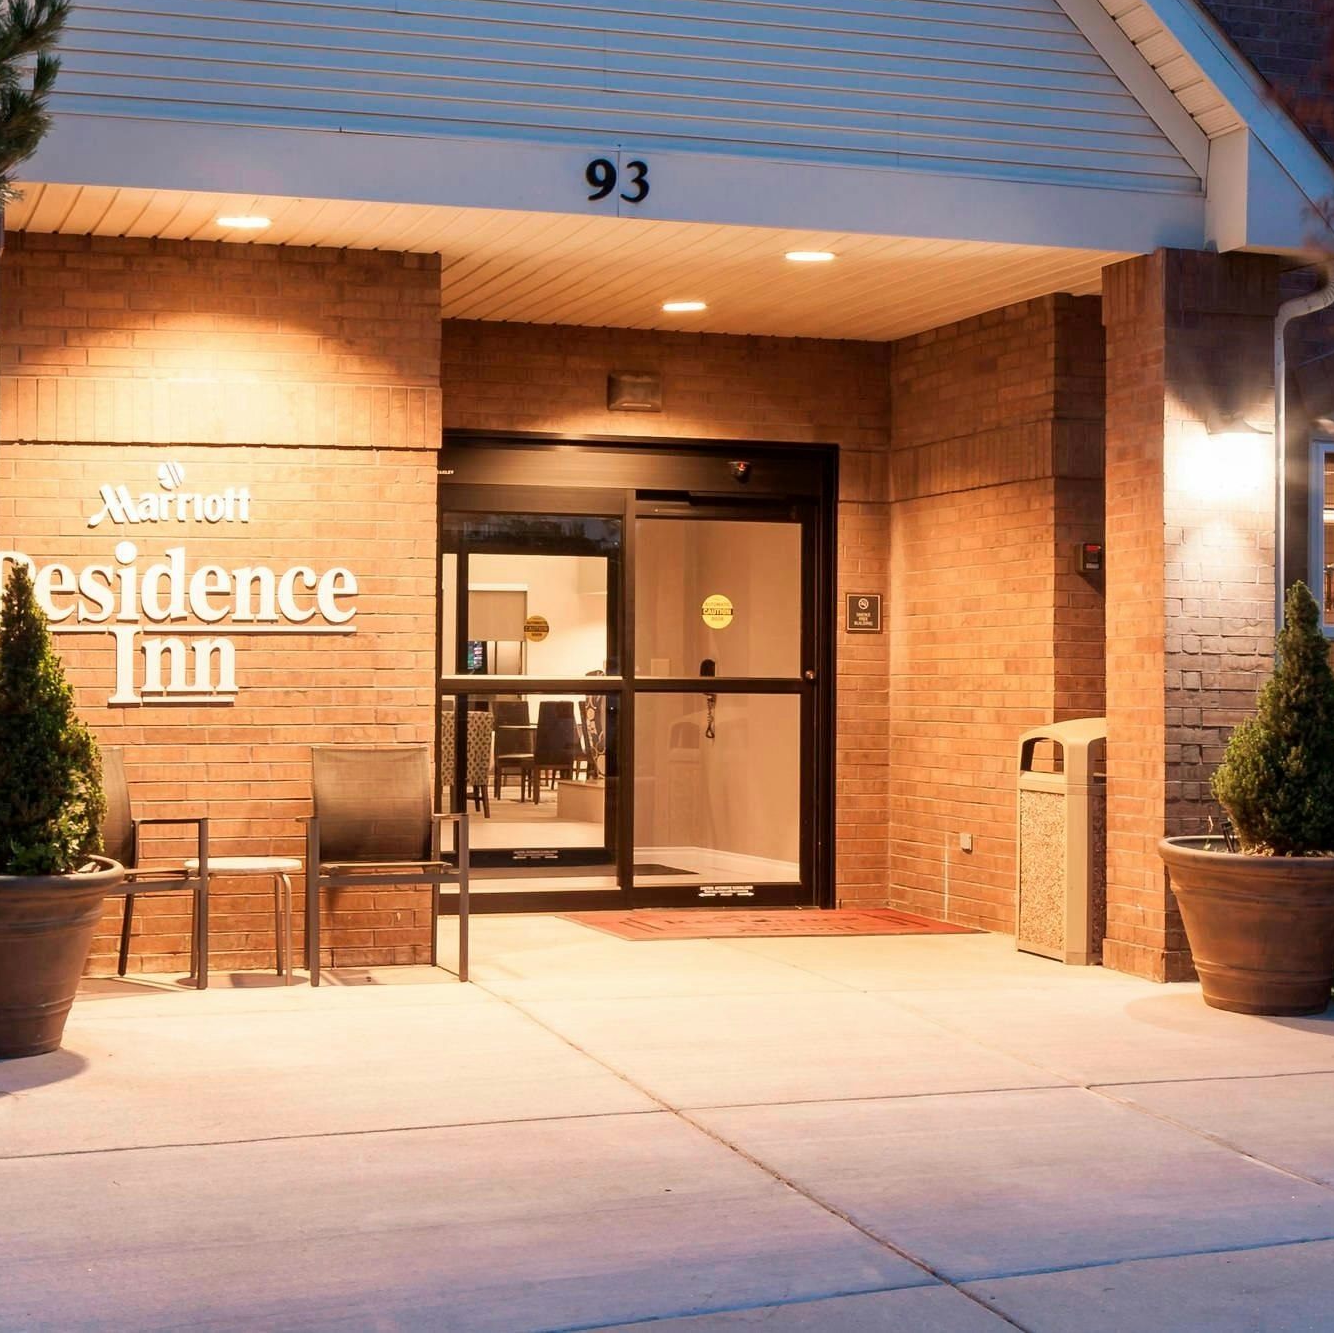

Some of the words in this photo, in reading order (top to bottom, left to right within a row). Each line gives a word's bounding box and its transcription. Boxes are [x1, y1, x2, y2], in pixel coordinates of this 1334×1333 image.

[585, 158, 650, 203] 93
[87, 483, 250, 528] Marriott
[108, 625, 239, 704] Inn
